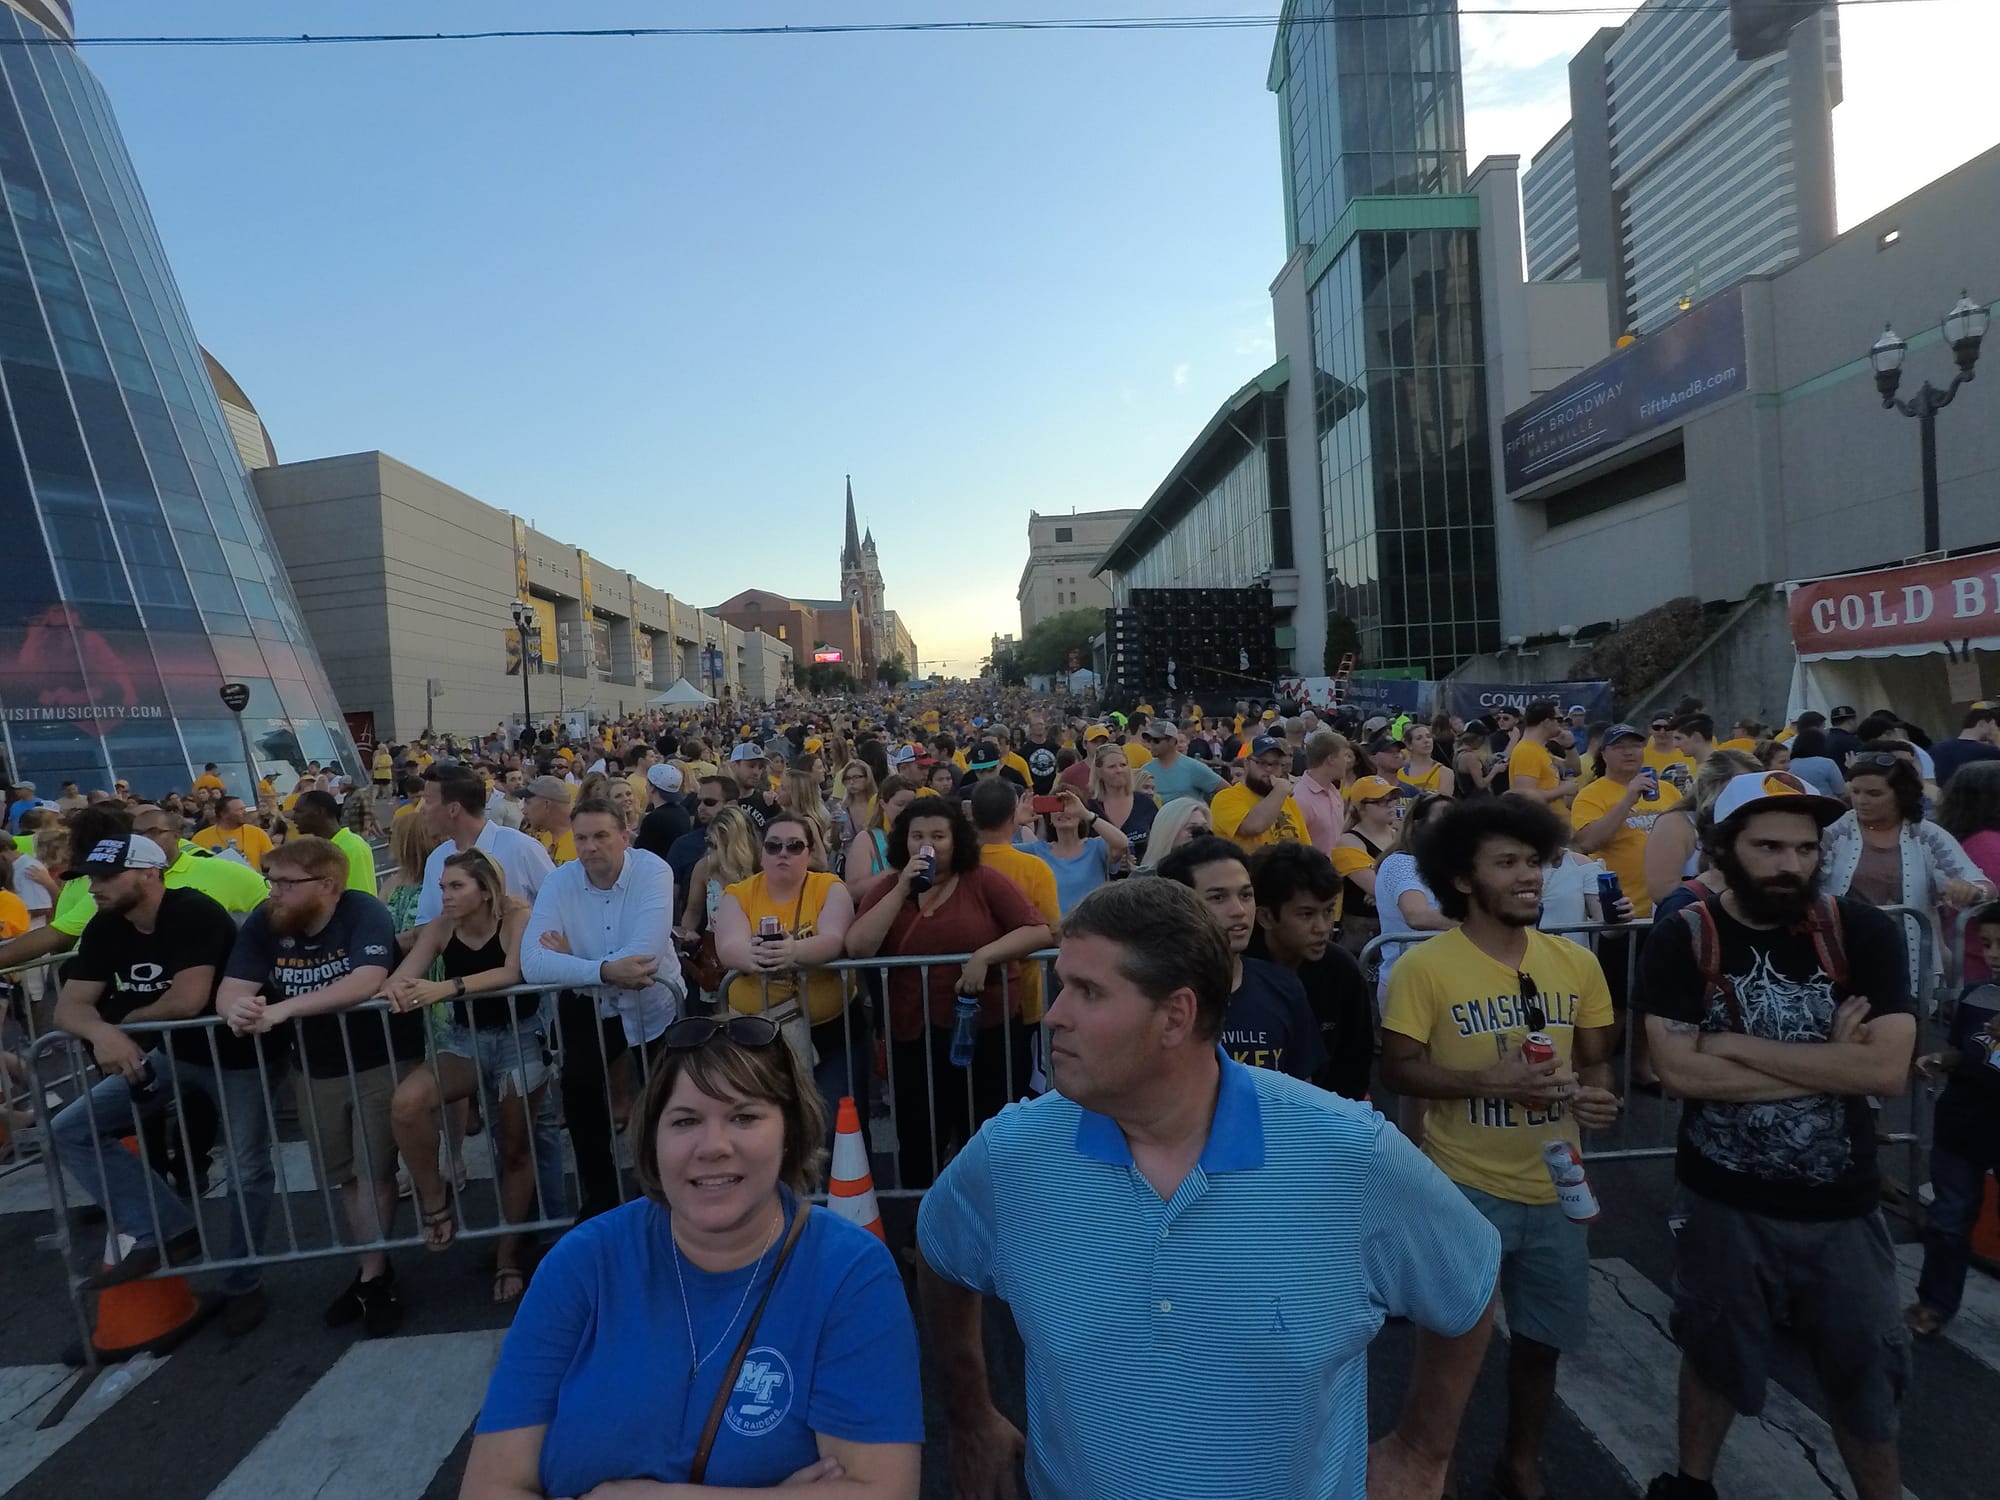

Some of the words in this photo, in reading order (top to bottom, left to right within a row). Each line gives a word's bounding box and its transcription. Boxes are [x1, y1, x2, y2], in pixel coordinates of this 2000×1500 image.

[1506, 431, 1535, 454] FIFTH
[1549, 382, 1623, 431] BROADWAY
[1812, 585, 1934, 634] COLD
[734, 1360, 784, 1403] MT
